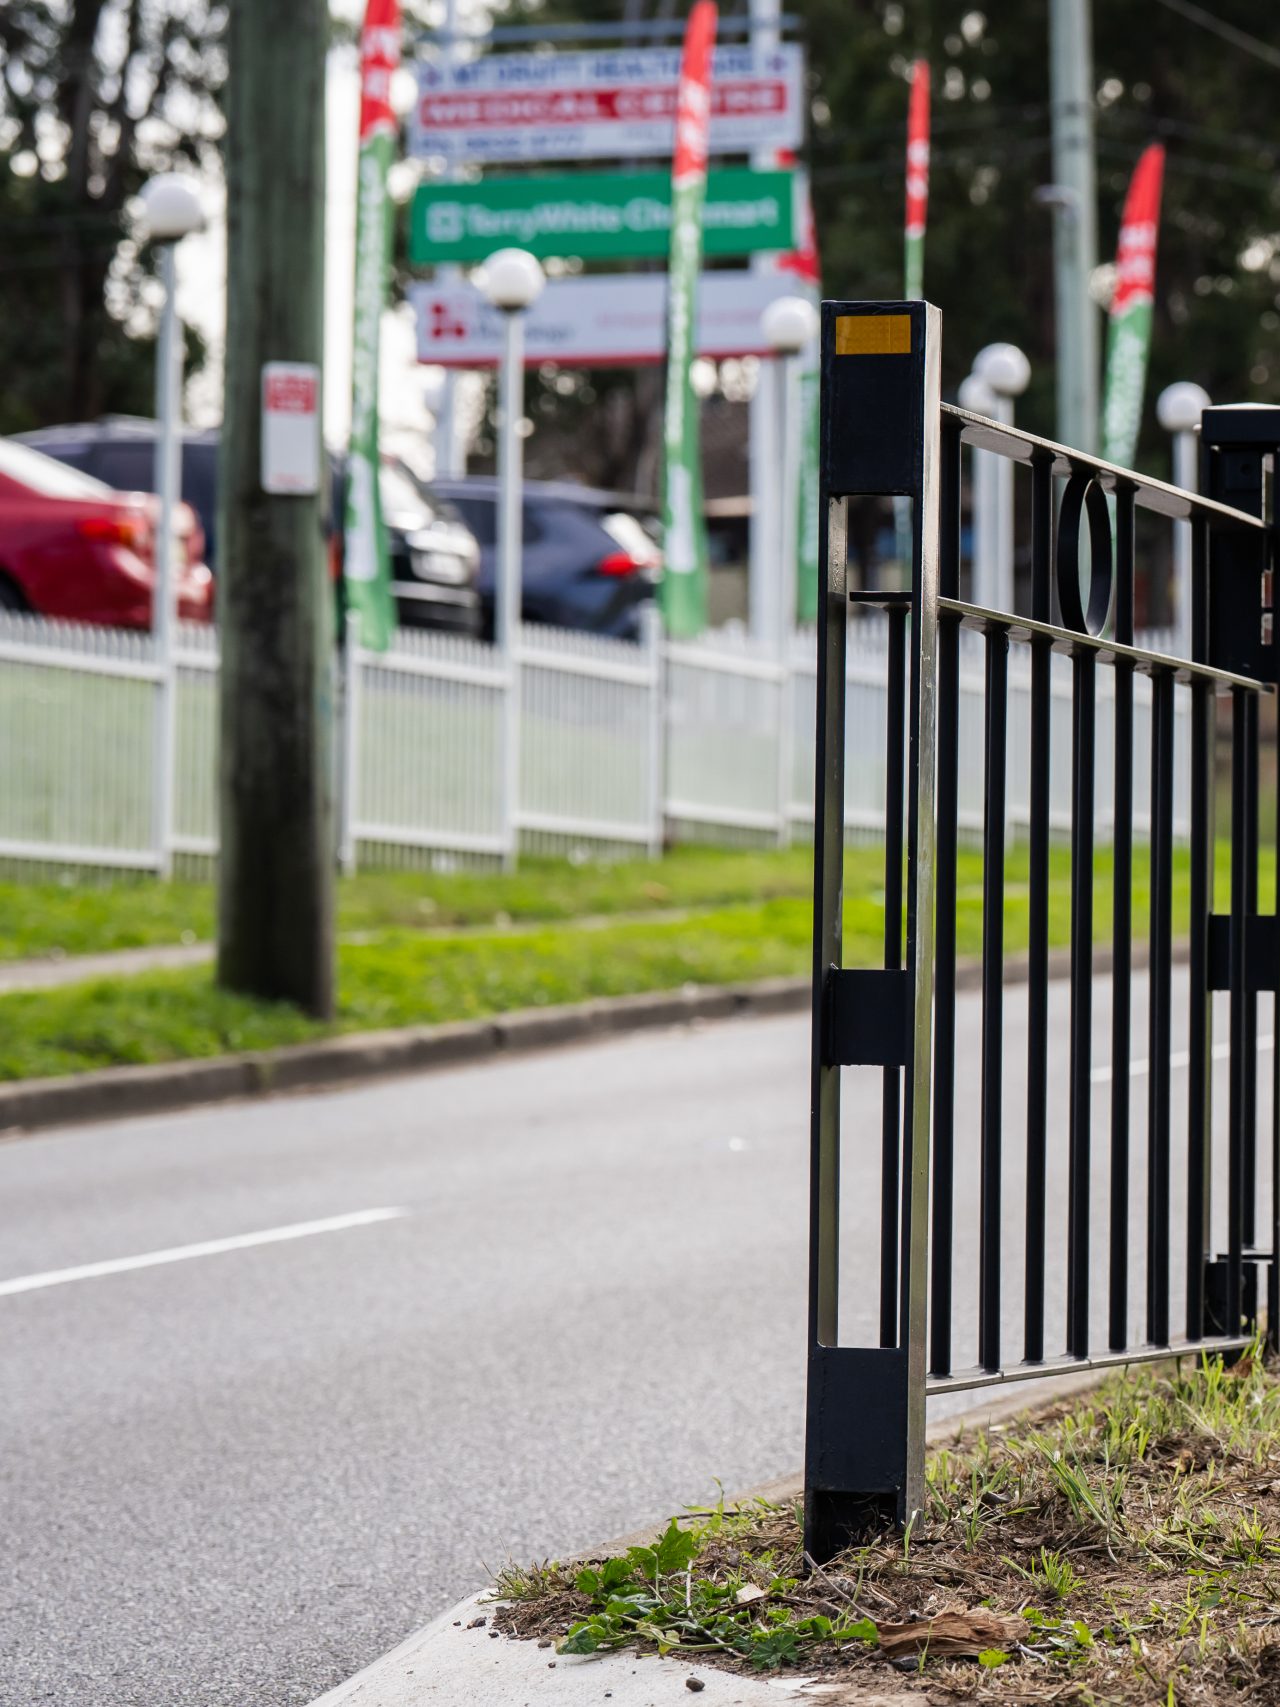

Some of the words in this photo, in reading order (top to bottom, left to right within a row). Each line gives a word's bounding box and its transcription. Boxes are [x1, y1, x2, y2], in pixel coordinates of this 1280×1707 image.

[427, 96, 602, 124] MEDICAL
[617, 84, 778, 112] CERE
[466, 198, 622, 242] TerryWhite
